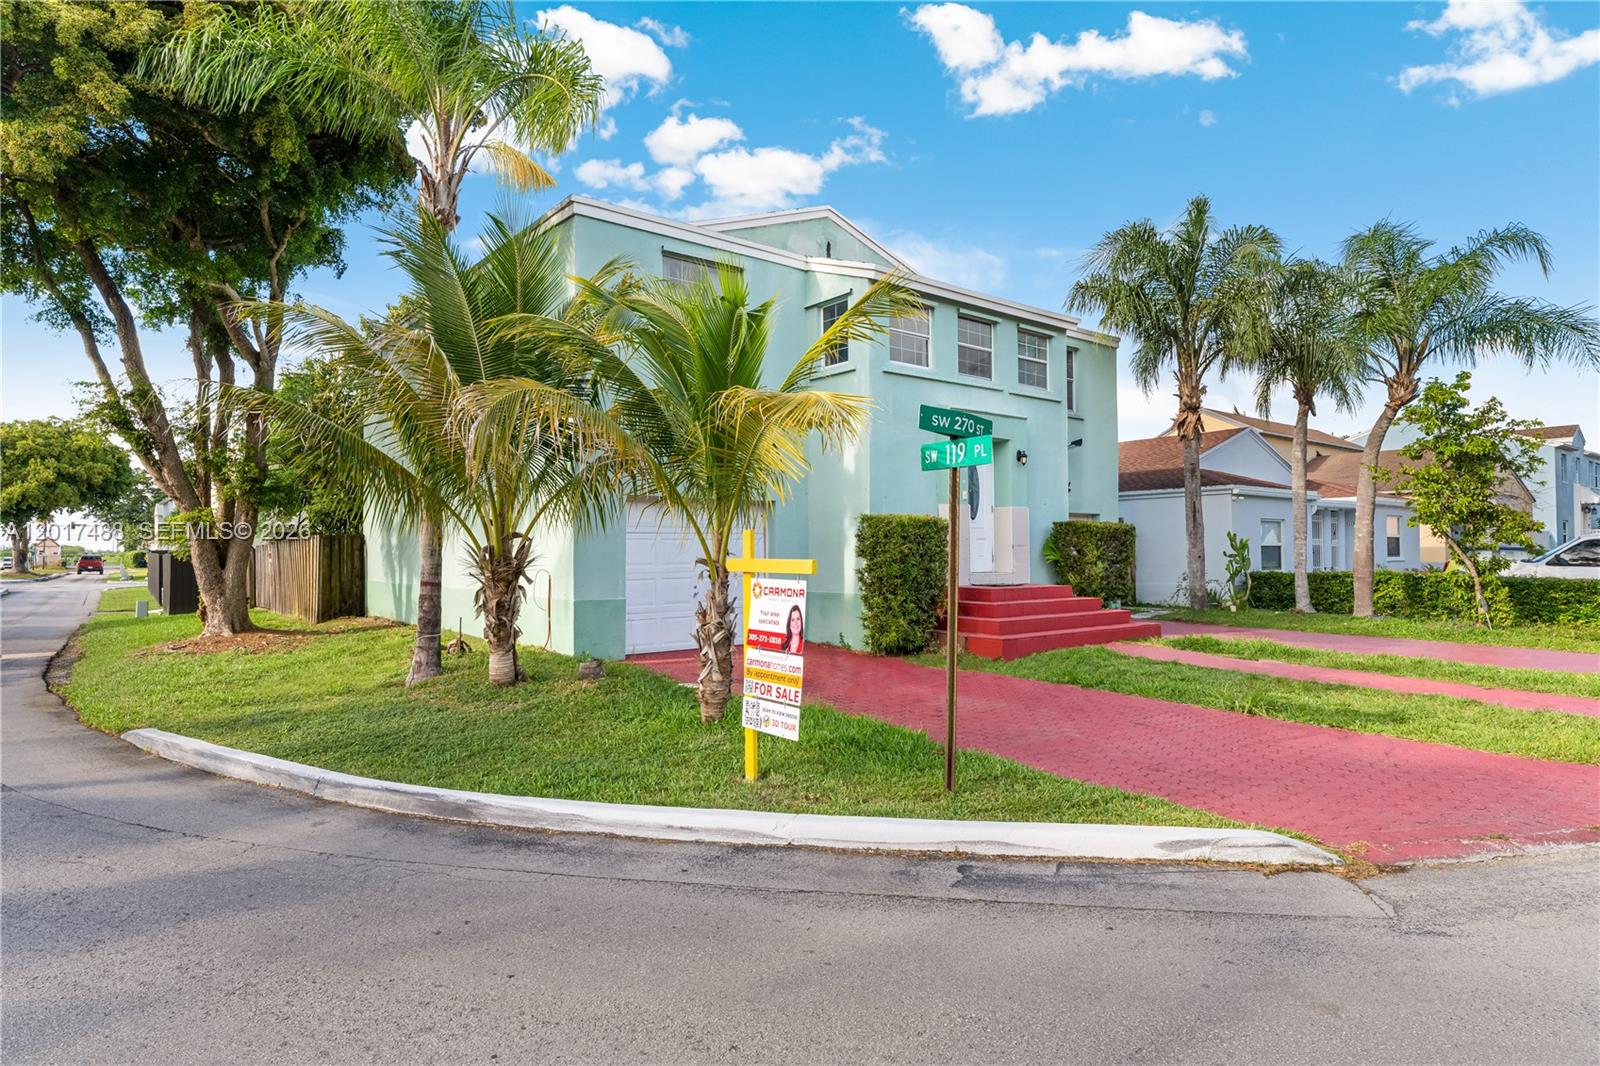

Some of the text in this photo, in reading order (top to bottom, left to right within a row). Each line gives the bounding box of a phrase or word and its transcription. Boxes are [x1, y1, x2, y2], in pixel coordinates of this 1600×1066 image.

[931, 415, 985, 435] SW 270 ST
[925, 442, 987, 465] SW 119 PL
[763, 586, 805, 598] CARMONA
[746, 658, 802, 674] carmonahomes.com
[746, 668, 754, 677] By
[755, 671, 786, 682] appointment
[754, 682, 800, 703] FOR SALE
[780, 721, 797, 732] TOUR
